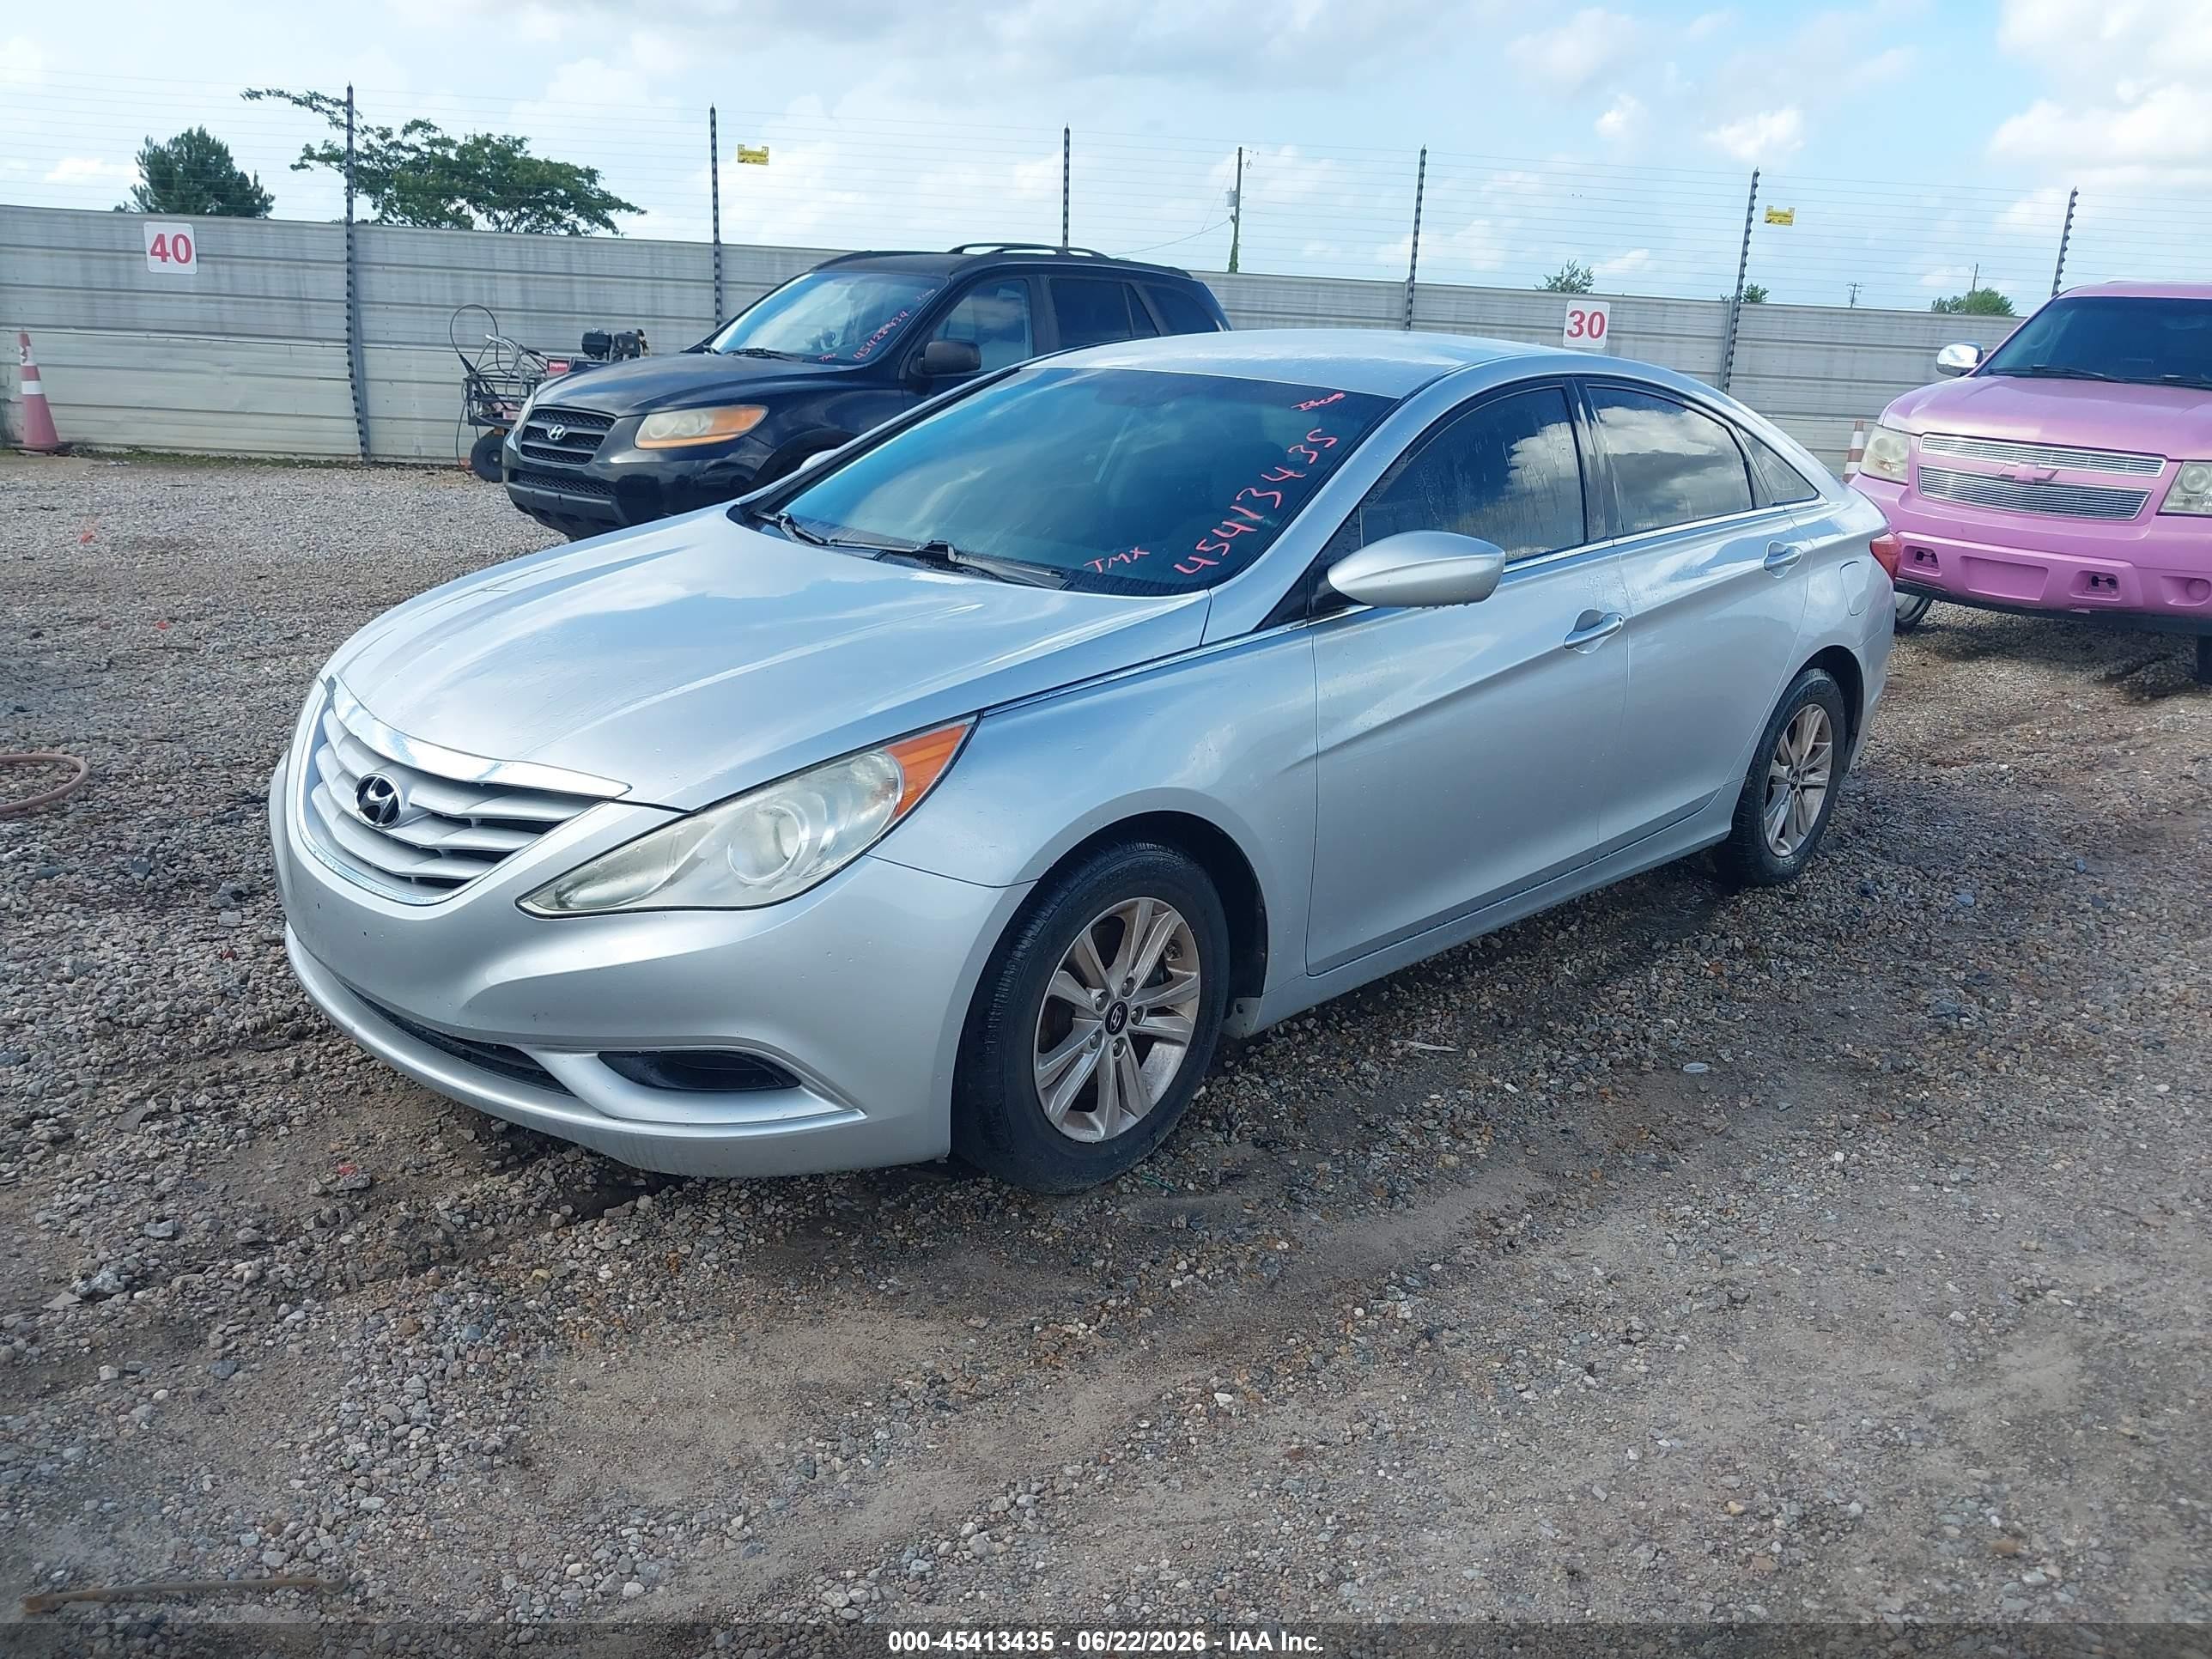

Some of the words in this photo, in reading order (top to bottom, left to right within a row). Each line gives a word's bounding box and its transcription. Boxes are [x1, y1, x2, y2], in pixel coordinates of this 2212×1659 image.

[150, 233, 192, 264] 40
[1566, 310, 1606, 339] 30
[1174, 428, 1338, 574] 45413435
[1084, 546, 1151, 574] TMX
